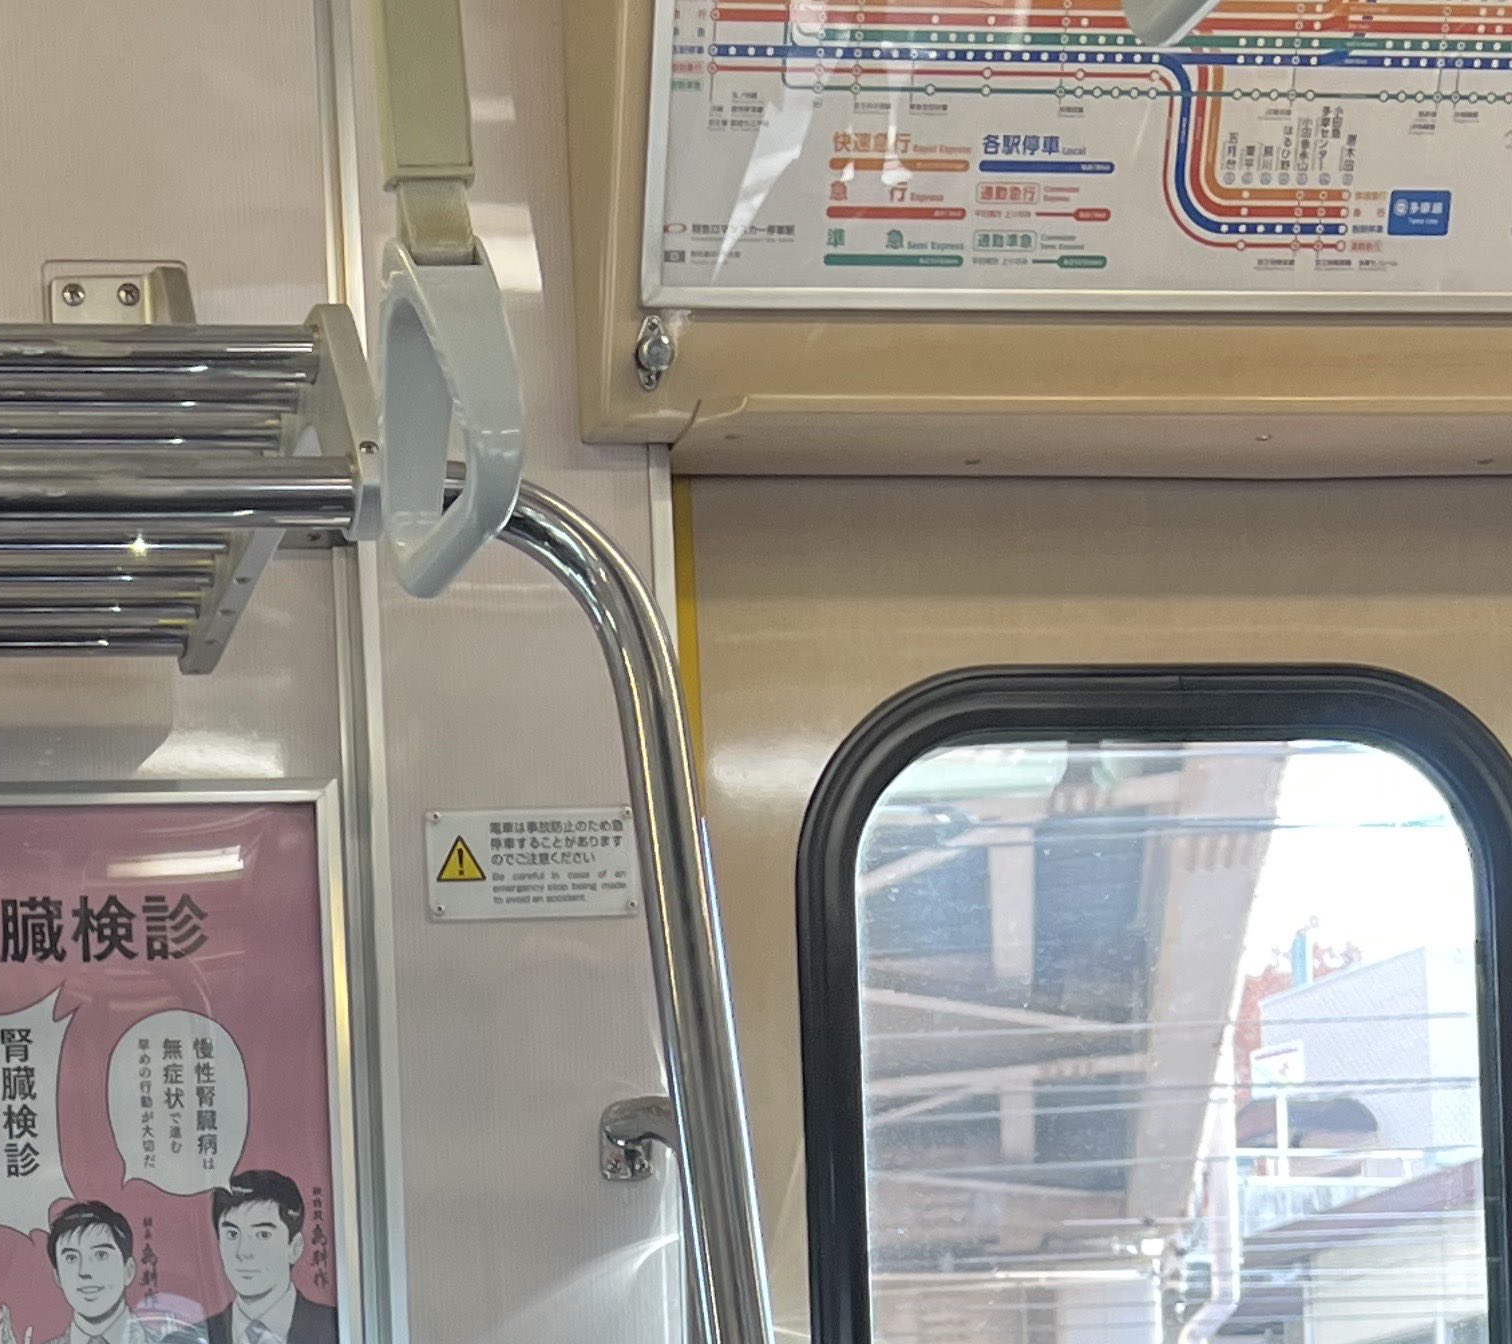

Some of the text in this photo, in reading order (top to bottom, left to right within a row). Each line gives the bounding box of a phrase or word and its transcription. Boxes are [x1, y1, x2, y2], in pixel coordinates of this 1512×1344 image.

[983, 134, 1060, 156] 各駅停車
[0, 1028, 40, 1178] 腎臓検診
[138, 1038, 156, 1169] 早めの行動が大切だ
[162, 1037, 185, 1154] 無症状で進む
[192, 1037, 218, 1170] 慢性腎臓病は
